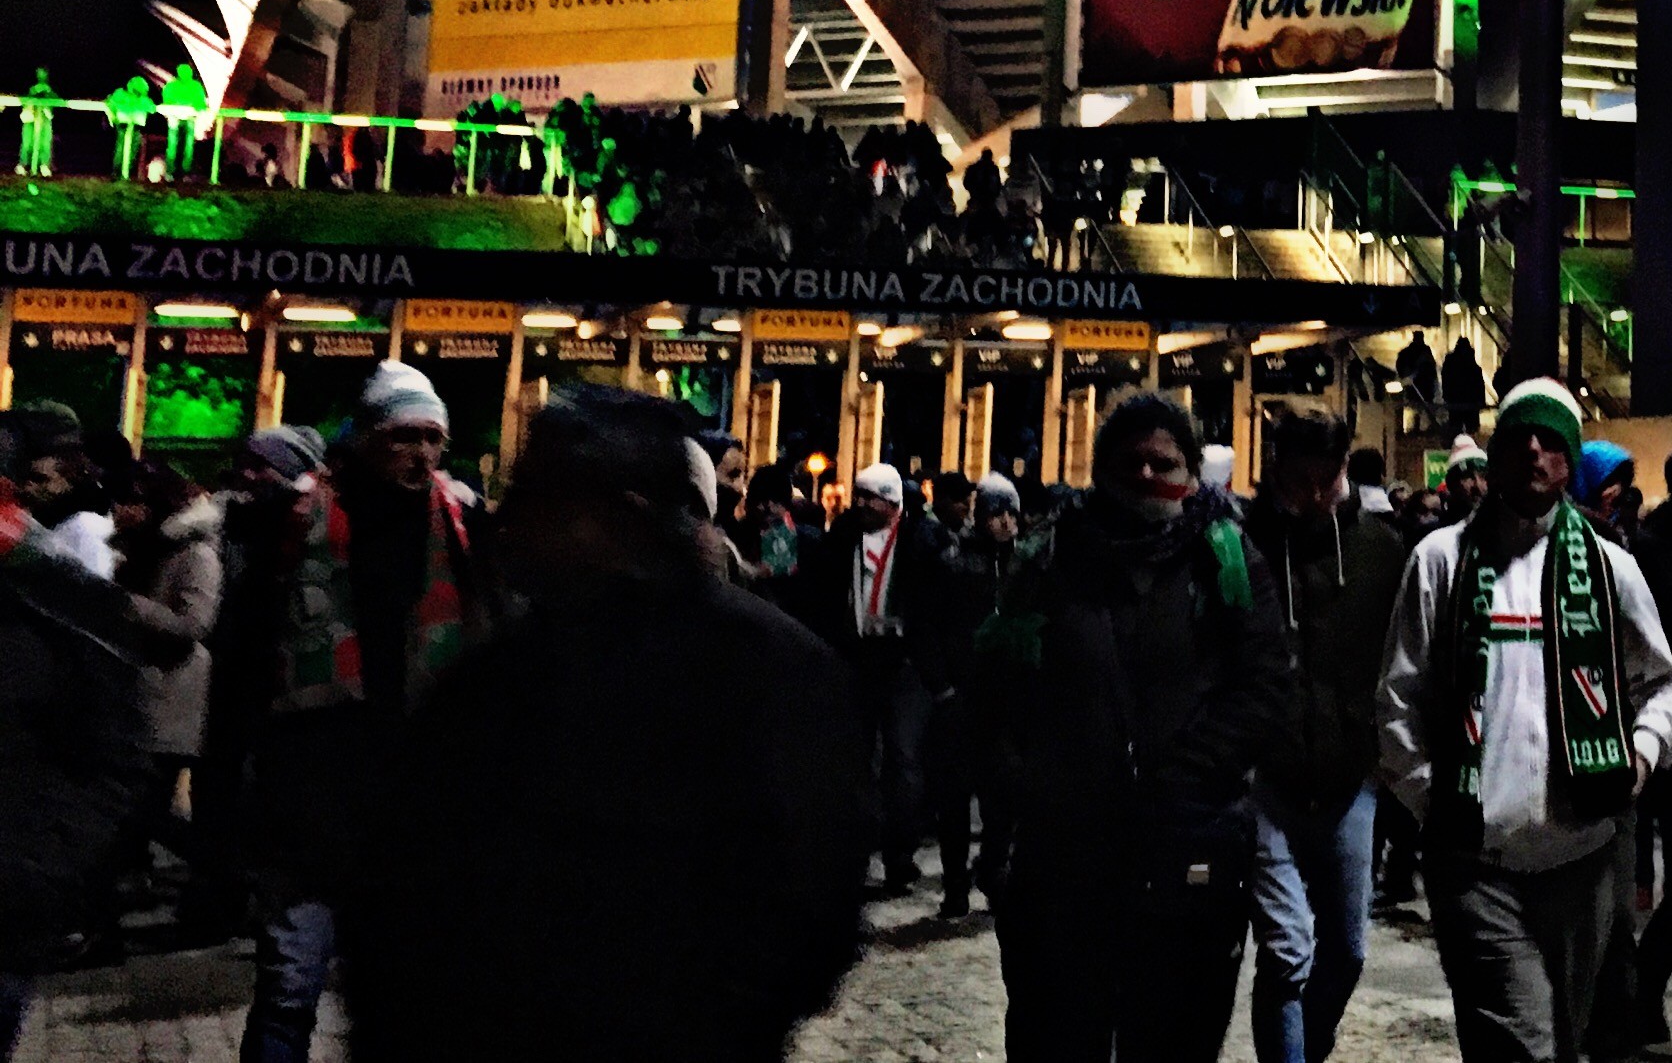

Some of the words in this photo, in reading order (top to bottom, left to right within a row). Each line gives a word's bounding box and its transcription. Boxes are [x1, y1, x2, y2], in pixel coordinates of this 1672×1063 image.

[5, 241, 112, 277] UNA
[127, 244, 414, 287] ZACHODNIA
[711, 264, 904, 303] TRYBUNA
[920, 272, 1143, 312] ZACHODNIA
[760, 313, 844, 329] FORTUNA
